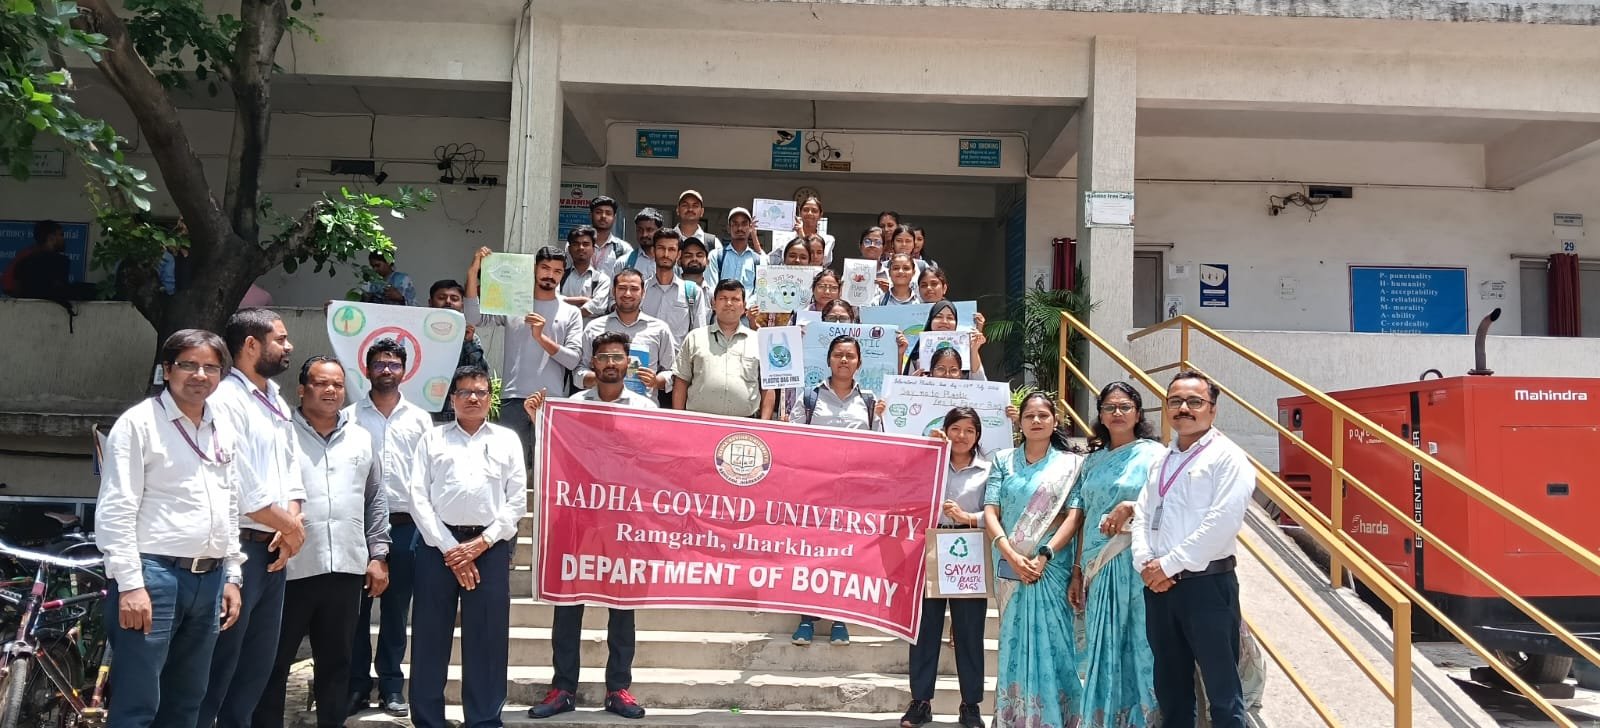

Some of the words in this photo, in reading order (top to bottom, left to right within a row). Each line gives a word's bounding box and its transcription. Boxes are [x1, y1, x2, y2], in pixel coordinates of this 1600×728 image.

[1564, 241, 1574, 251] 29
[1389, 272, 1432, 281] punctuality
[1391, 280, 1426, 288] humanity
[1390, 289, 1438, 297] acceptability
[1391, 296, 1428, 305] reliability
[1393, 304, 1424, 313] morality
[1391, 312, 1416, 320] ability
[828, 326, 847, 337] SAY
[848, 327, 861, 338] NO
[1514, 389, 1588, 401] Mahindra
[555, 480, 644, 512] RADHA
[652, 489, 756, 522] GOVIND
[765, 500, 922, 541] UNIVERSITY
[616, 523, 726, 552] Ramgarh,
[732, 532, 854, 557] Jharkhand
[944, 563, 966, 575] SAY
[561, 553, 741, 586] DEPARTMENT
[748, 566, 784, 589] OF
[791, 566, 898, 607] BOTANY
[957, 575, 982, 586] PLASTIC
[958, 582, 978, 590] BAGS
